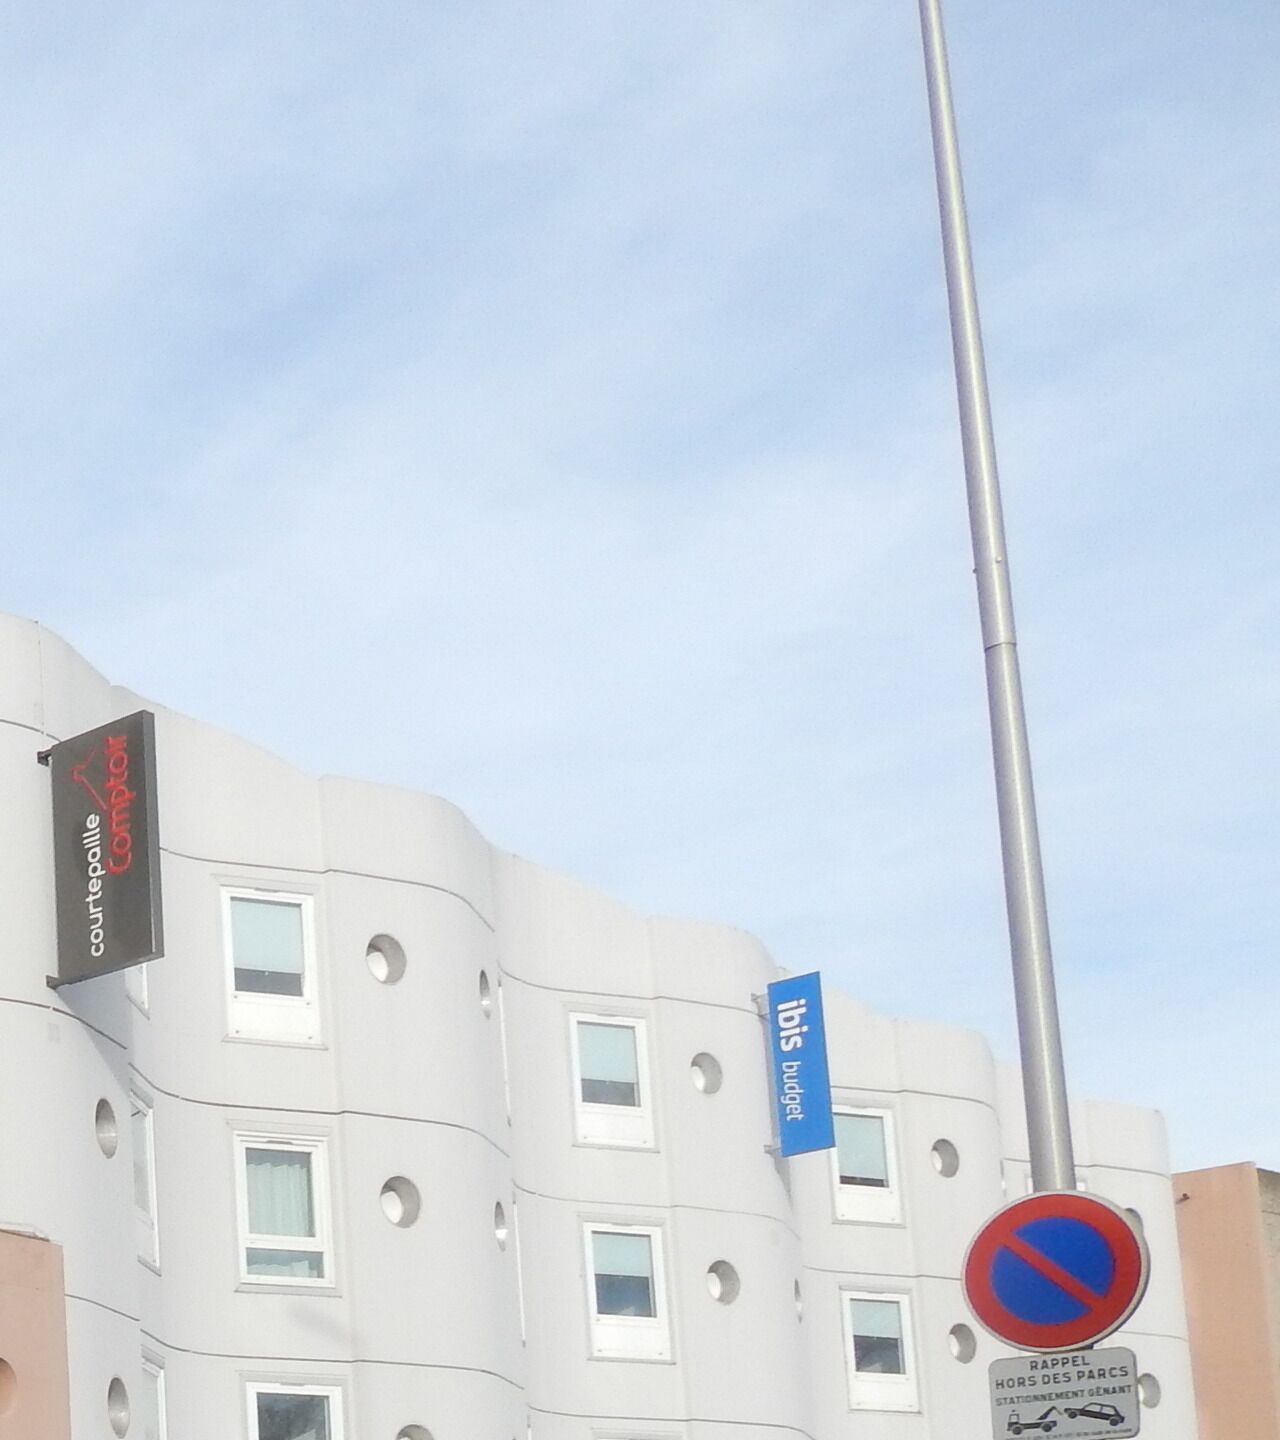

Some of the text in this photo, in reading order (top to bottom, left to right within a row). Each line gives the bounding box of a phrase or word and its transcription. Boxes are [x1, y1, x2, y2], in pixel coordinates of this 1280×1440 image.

[82, 812, 107, 957] courtepaille
[777, 998, 809, 1121] ibis budget
[1030, 1355, 1091, 1371] RAPPEL
[995, 1366, 1129, 1390] HORS DES PARCS
[995, 1389, 1085, 1406] STATIONNEMENT
